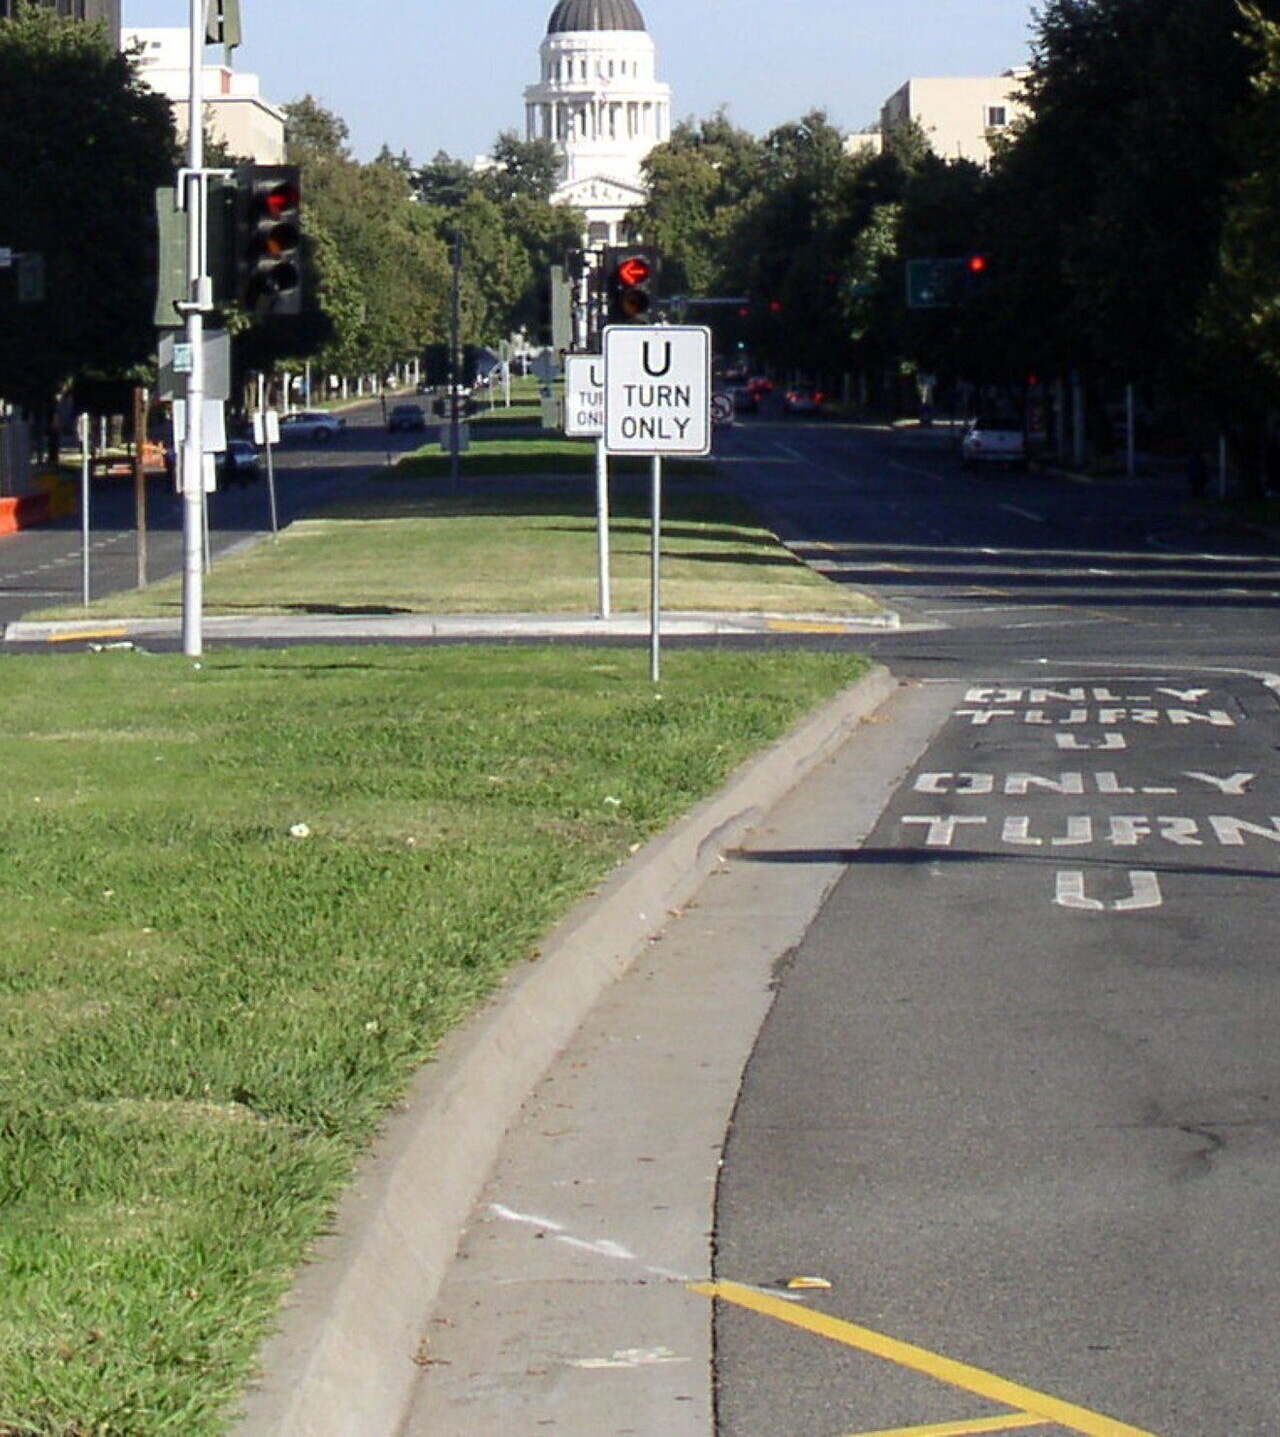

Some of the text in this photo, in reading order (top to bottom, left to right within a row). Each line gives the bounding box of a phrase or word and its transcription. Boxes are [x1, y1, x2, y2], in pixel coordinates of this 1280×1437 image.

[642, 340, 671, 377] U
[579, 391, 603, 407] TU
[623, 384, 691, 407] TURN
[577, 411, 603, 426] ON
[621, 416, 691, 439] ONLY
[963, 686, 1210, 704] ONLY
[953, 708, 1235, 726] TURN
[1054, 732, 1127, 750] U
[913, 771, 1257, 795] ONLY
[1051, 870, 1164, 911] U
